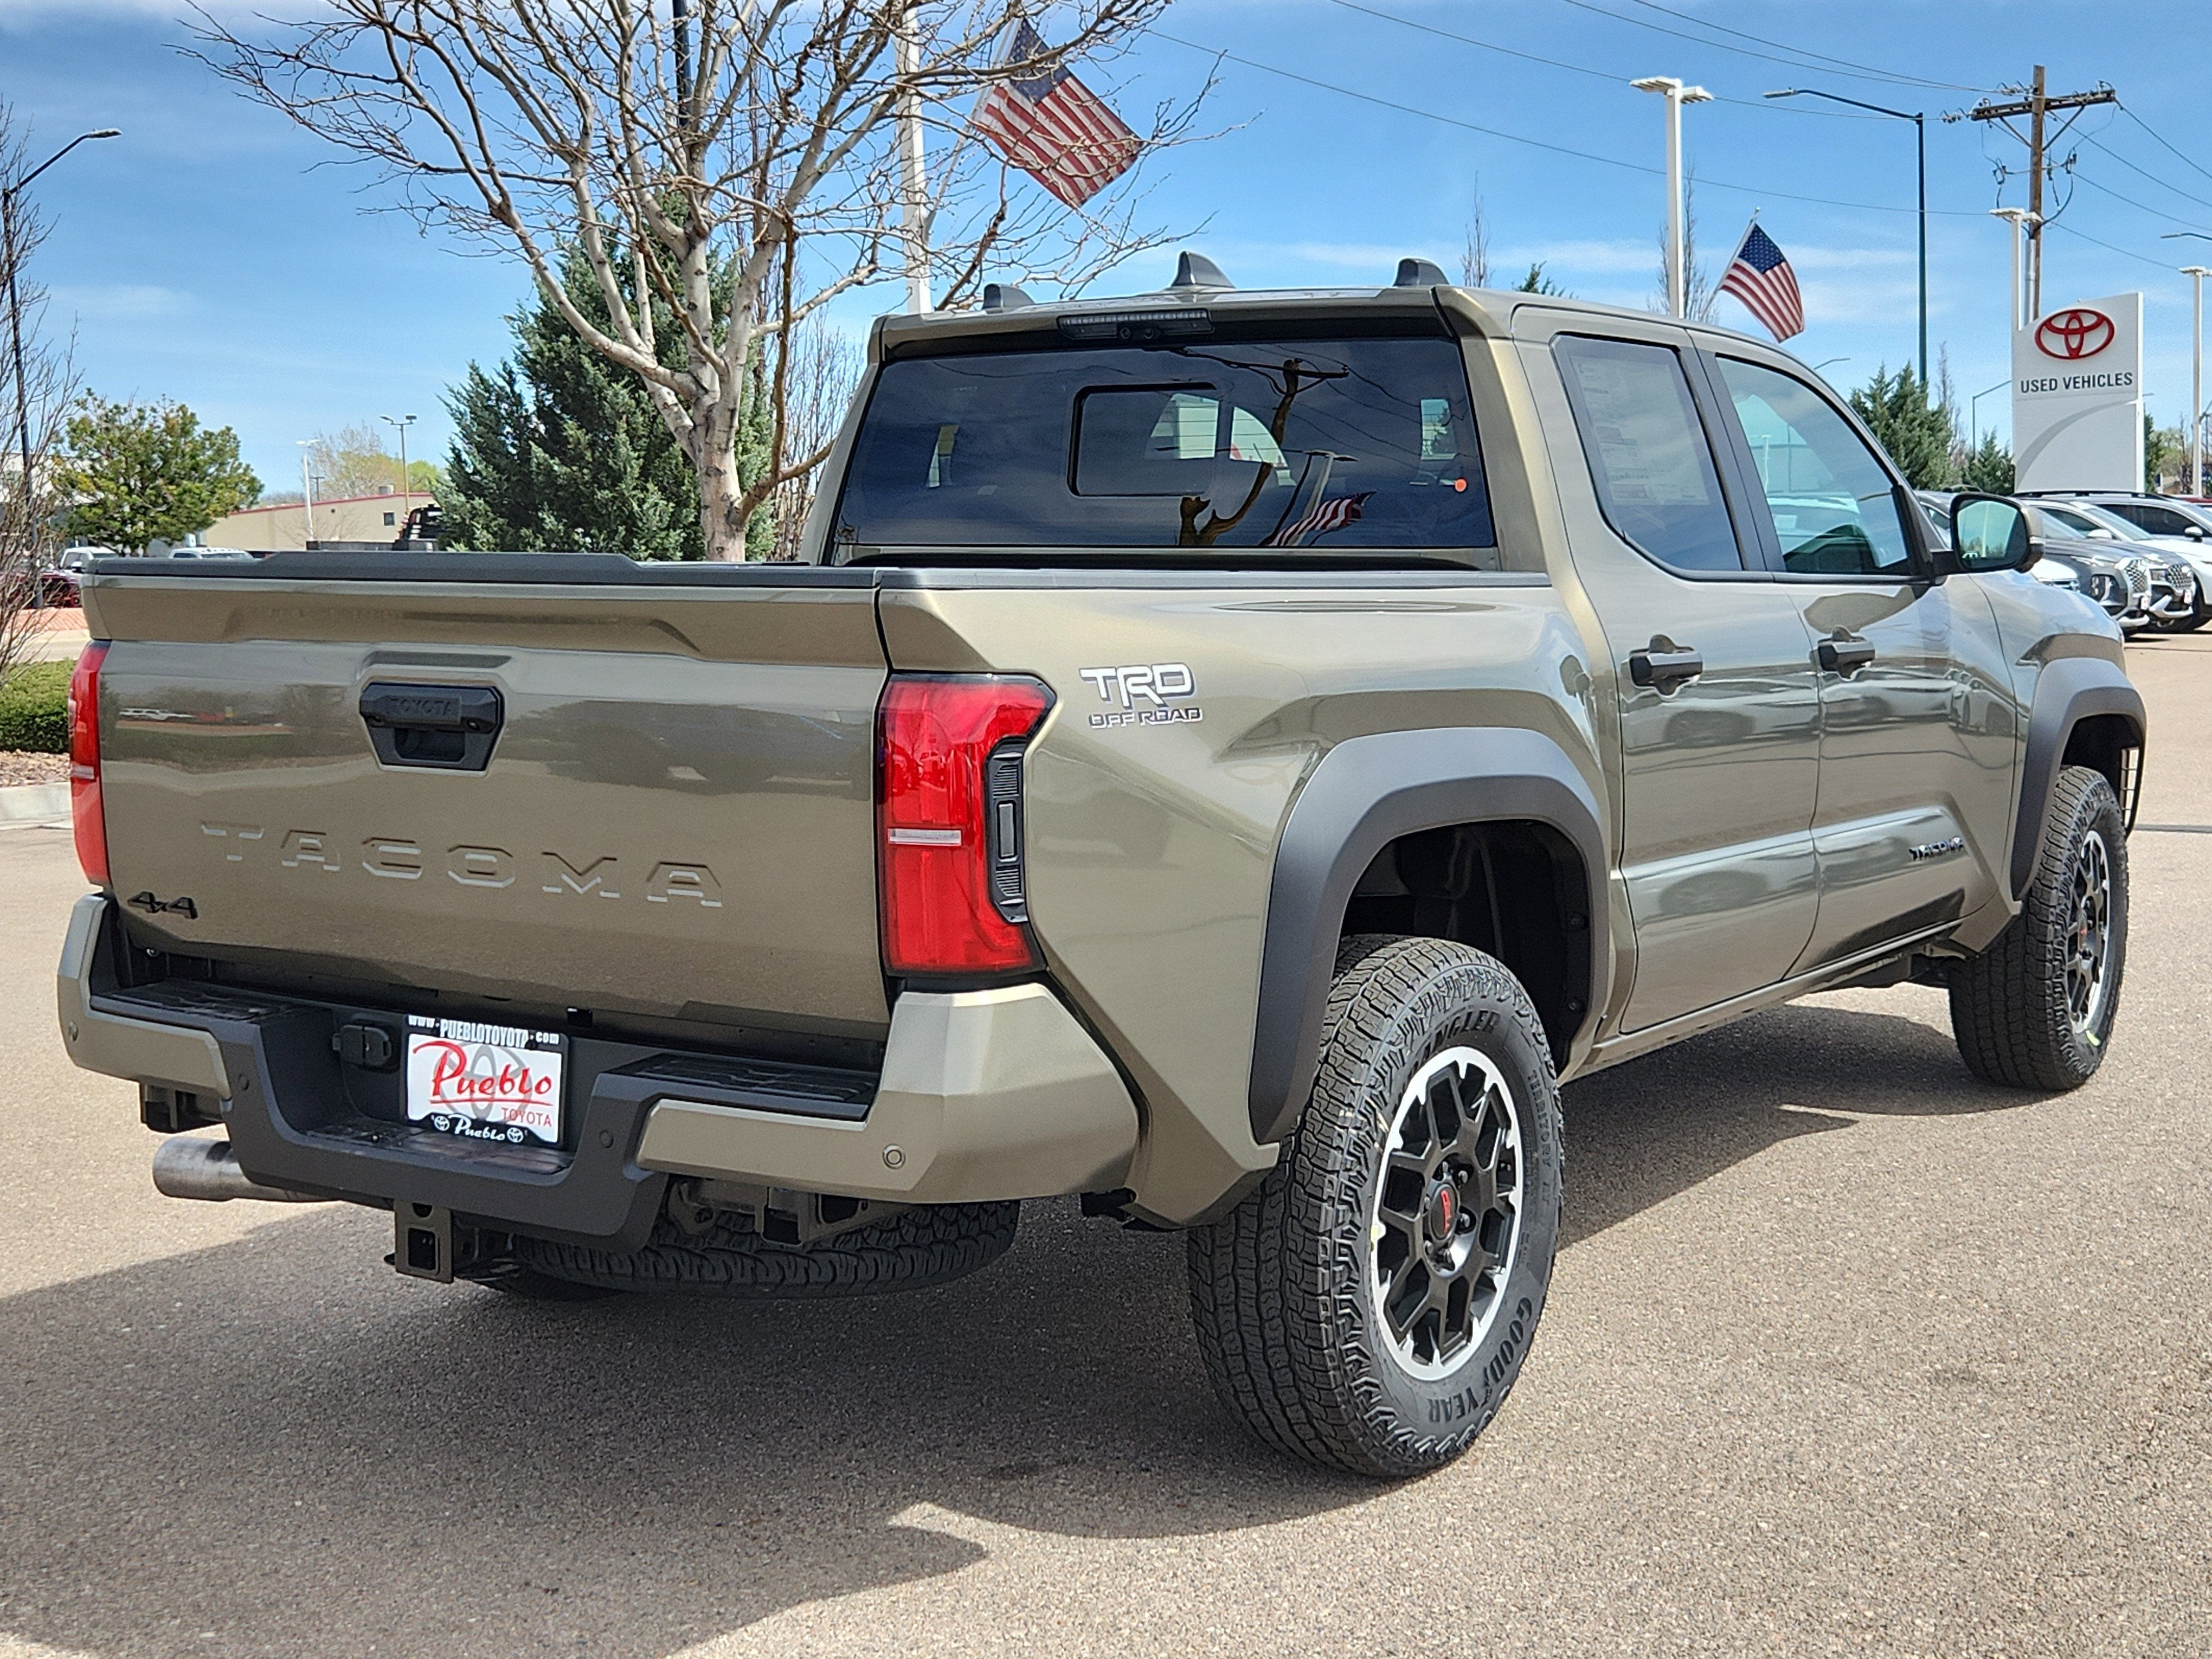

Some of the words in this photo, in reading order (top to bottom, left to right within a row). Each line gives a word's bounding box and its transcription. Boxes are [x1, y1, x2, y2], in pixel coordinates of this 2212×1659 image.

[2021, 378, 2058, 394] USED
[2062, 371, 2133, 390] VEHICLES
[1079, 663, 1196, 710] TRD
[1089, 712, 1135, 729] OFF
[1139, 707, 1203, 726] ROAD
[201, 820, 723, 908] TACOMA
[413, 1040, 552, 1097] Pueblo
[448, 1113, 506, 1141] Pueblo
[501, 1107, 552, 1127] TOYOTA
